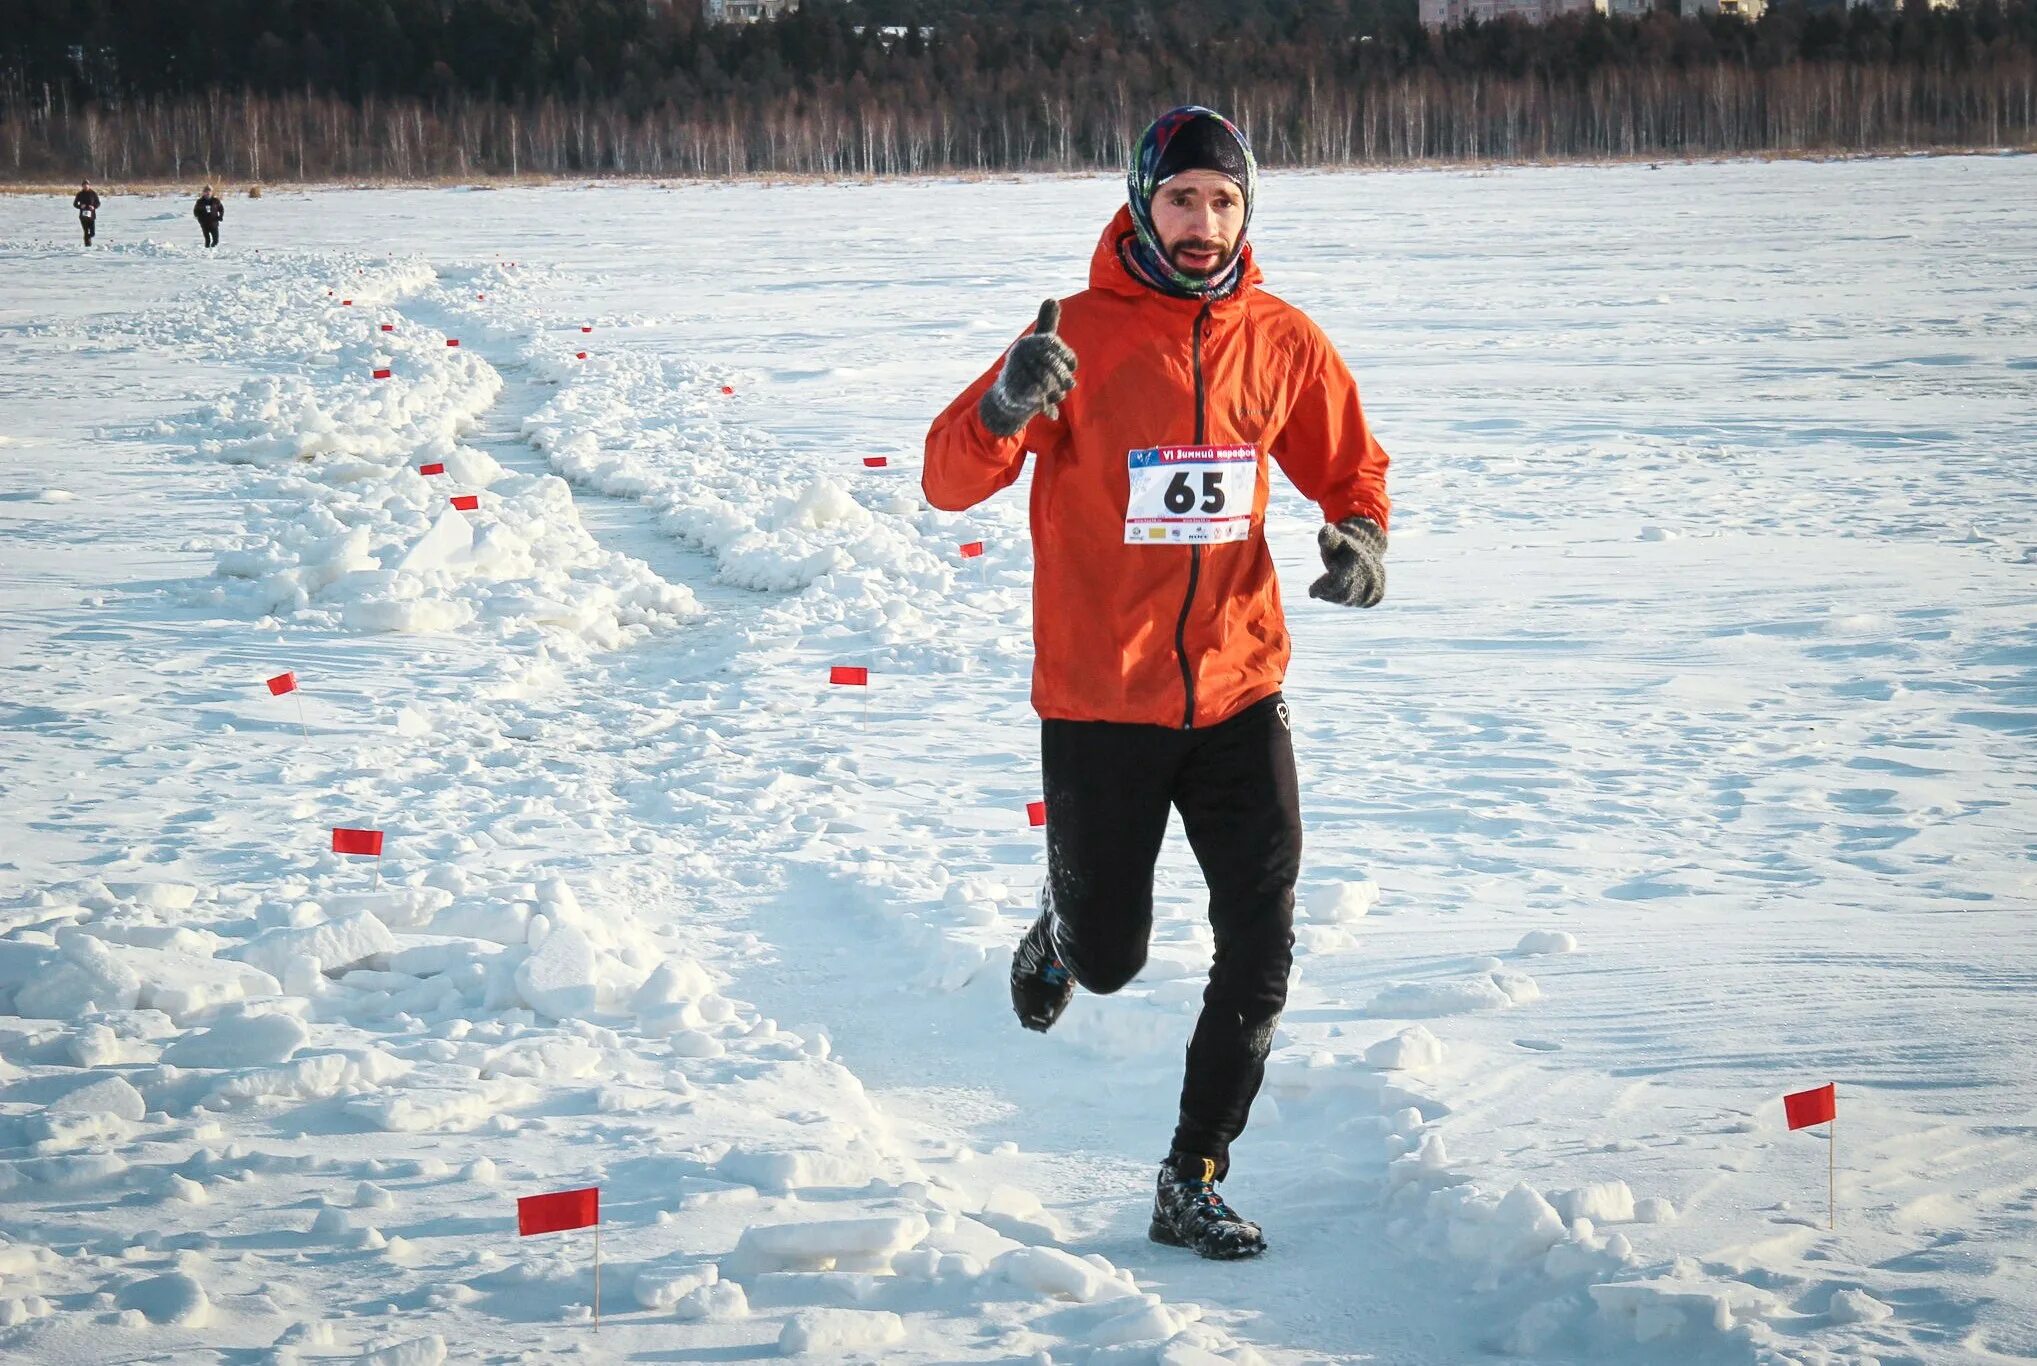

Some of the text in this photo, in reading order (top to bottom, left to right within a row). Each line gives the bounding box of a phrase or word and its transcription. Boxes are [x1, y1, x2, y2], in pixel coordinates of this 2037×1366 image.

[1163, 450, 1174, 460] VI
[1177, 448, 1214, 460] Зимний
[1164, 472, 1225, 514] 65
